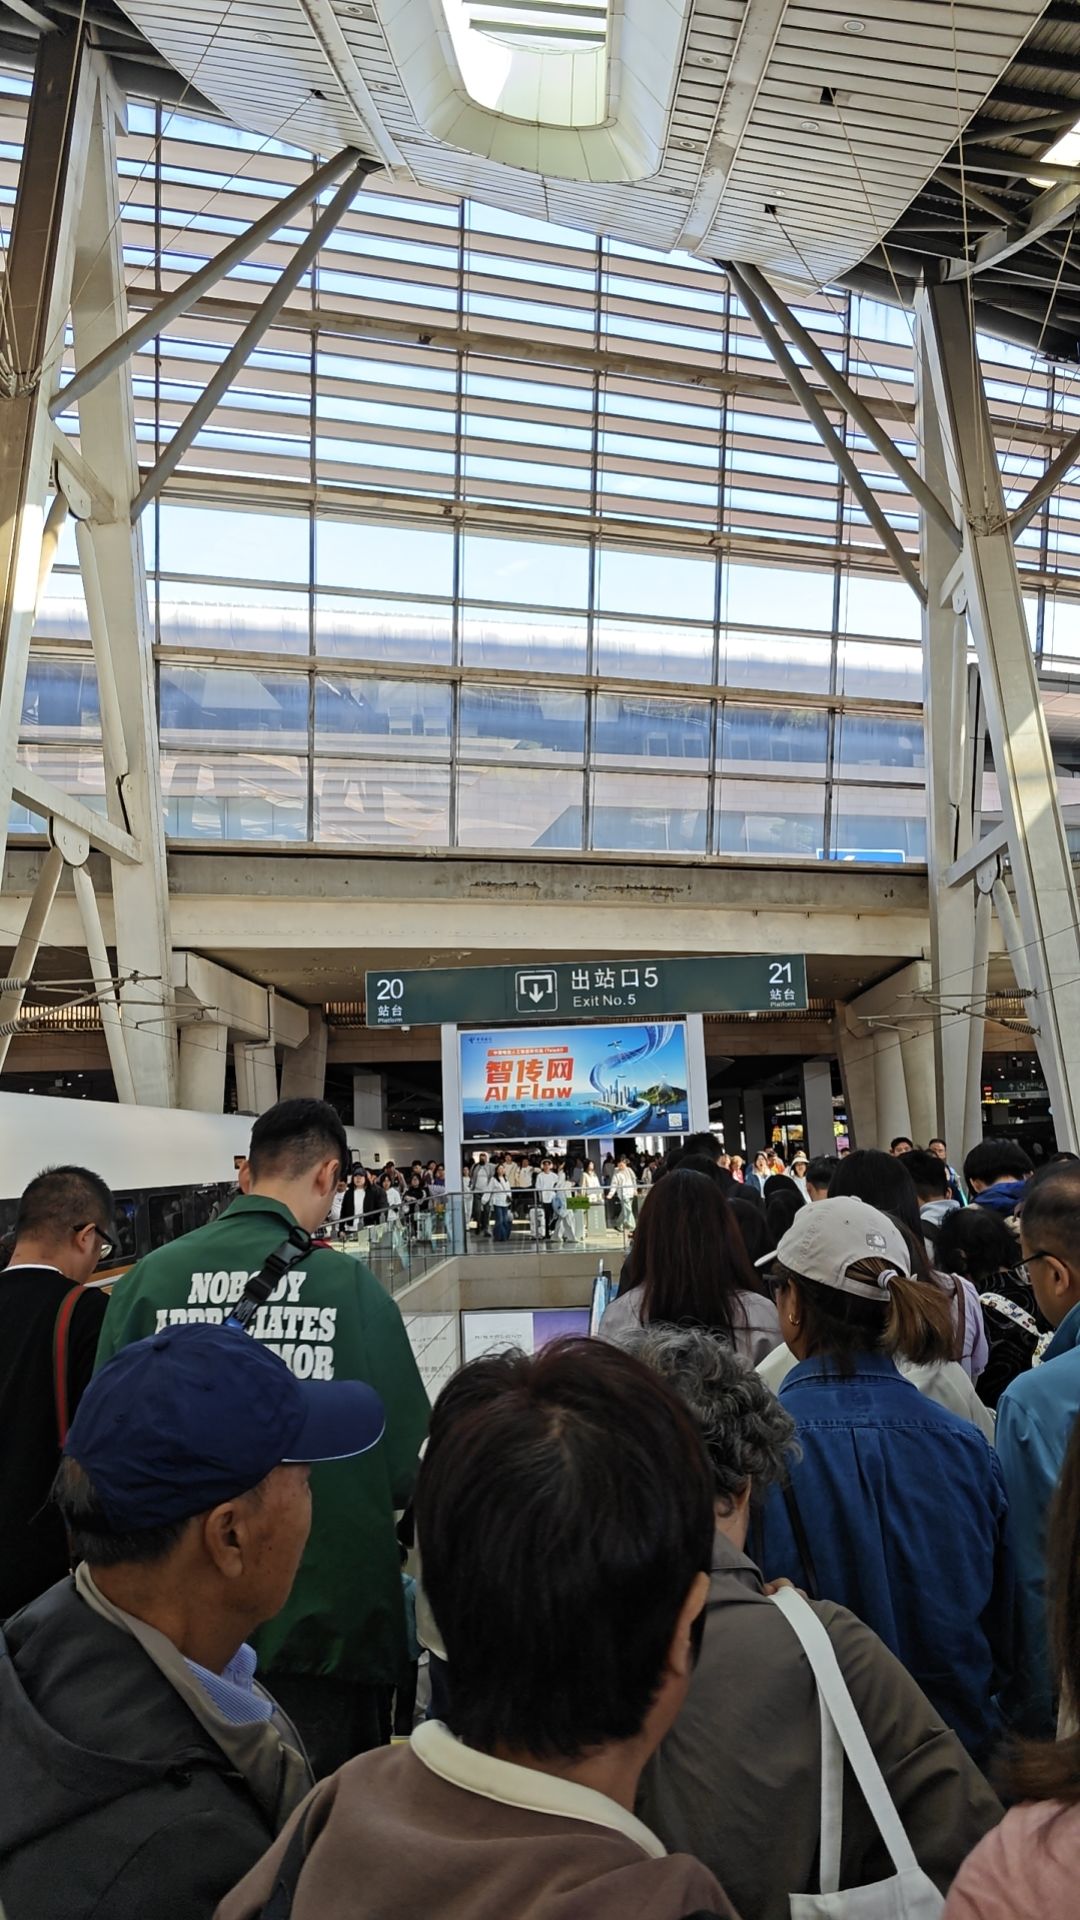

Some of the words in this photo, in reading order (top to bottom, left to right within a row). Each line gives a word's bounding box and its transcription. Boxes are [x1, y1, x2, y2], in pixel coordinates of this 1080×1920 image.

[571, 967, 658, 990] 出站口5
[768, 962, 793, 984] 21
[376, 978, 404, 1000] 20
[769, 988, 796, 1001] 站台
[377, 1004, 403, 1017] 站台
[573, 995, 599, 1007] Exit
[485, 1057, 574, 1084] 智传网
[484, 1086, 509, 1102] AI
[515, 1083, 573, 1100] Flow
[187, 1270, 307, 1304] NOBDY
